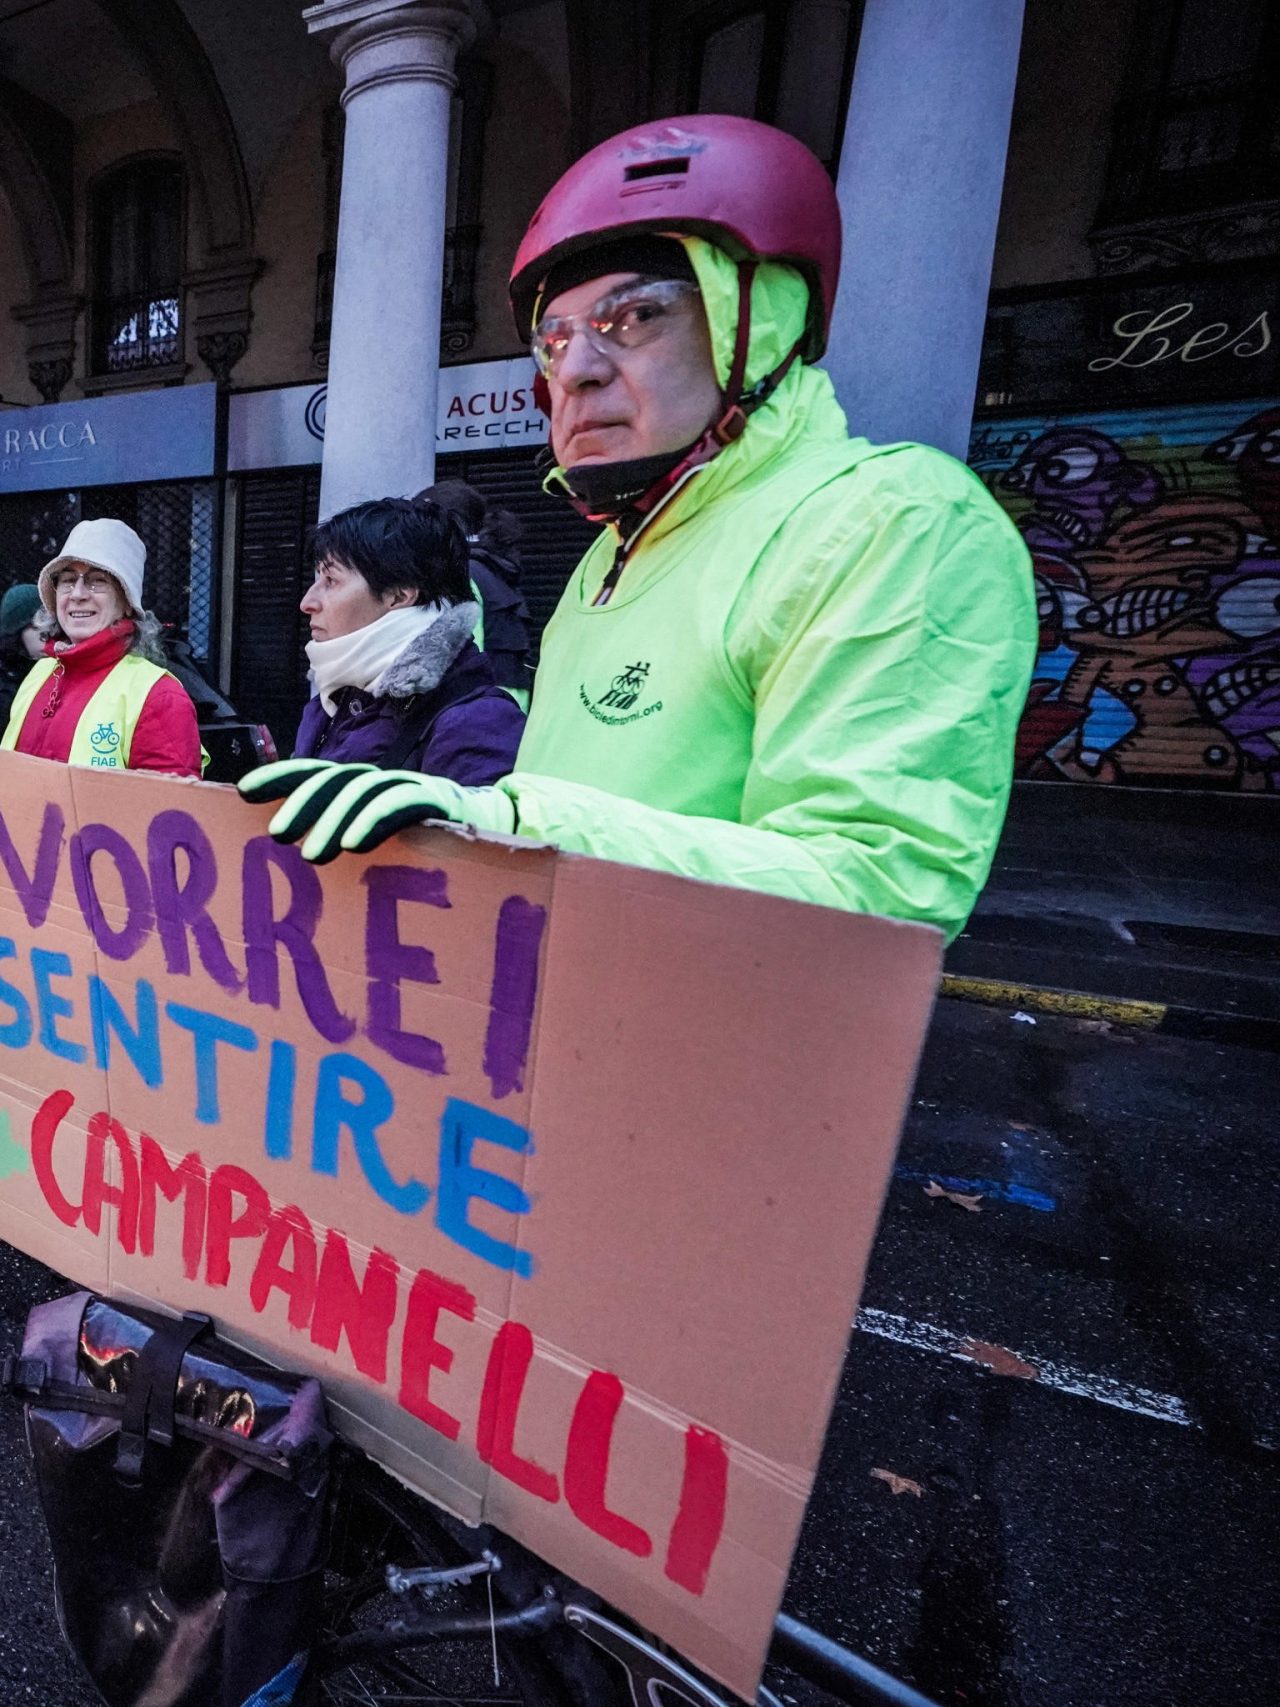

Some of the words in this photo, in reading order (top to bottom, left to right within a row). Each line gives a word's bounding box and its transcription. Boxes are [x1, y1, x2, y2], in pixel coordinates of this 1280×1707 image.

[1087, 302, 1271, 372] Les
[4, 420, 97, 454] RACCA
[91, 756, 117, 767] FIAB
[29, 1089, 730, 1597] CAMPANELLI
